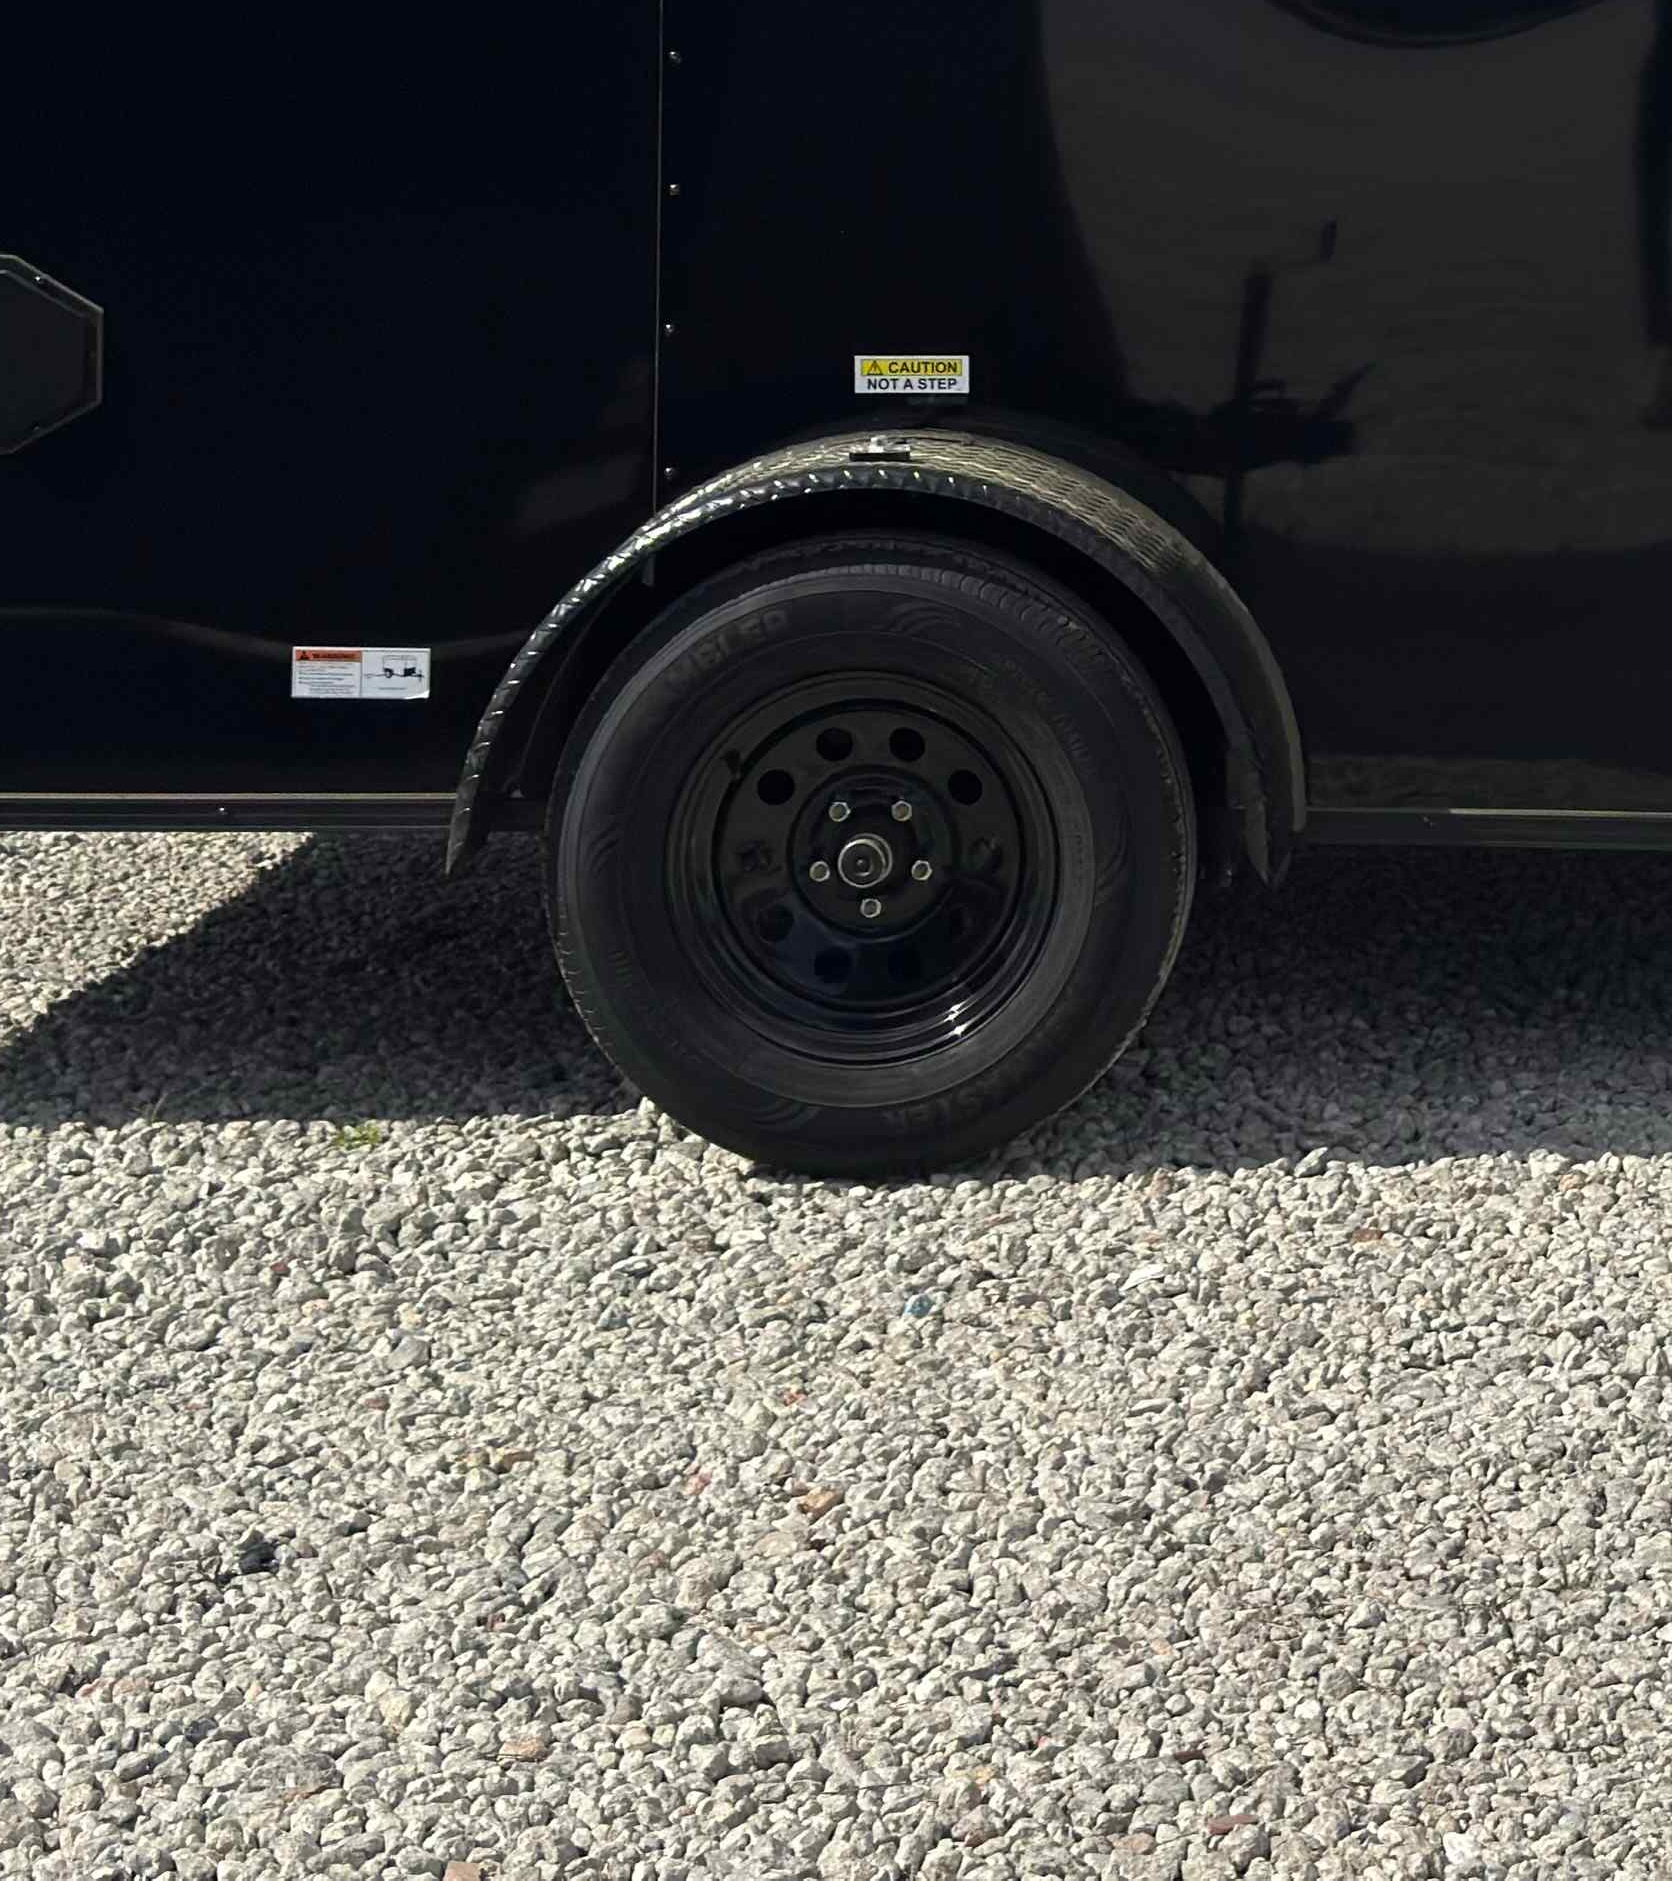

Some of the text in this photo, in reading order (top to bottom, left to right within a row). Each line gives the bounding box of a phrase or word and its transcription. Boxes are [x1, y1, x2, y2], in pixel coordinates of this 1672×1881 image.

[888, 361, 958, 374] CAUTION
[867, 378, 958, 391] NOT A STEP
